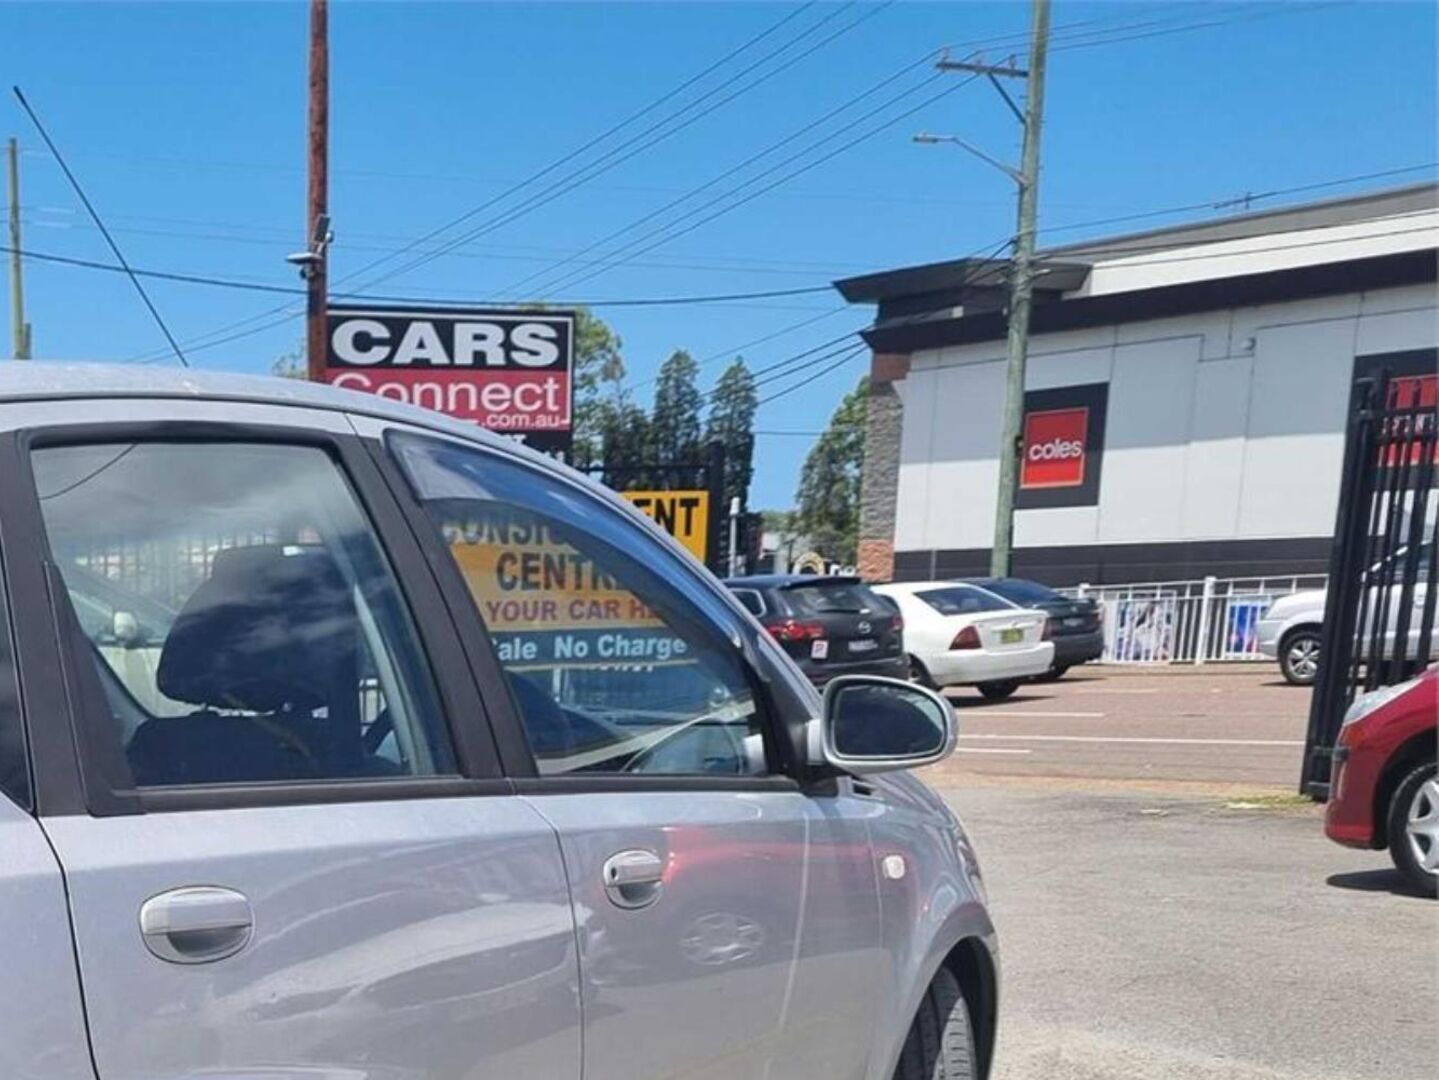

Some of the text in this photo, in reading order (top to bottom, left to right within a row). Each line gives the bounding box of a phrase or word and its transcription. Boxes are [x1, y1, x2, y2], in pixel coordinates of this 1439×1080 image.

[331, 319, 560, 367] CARS
[1029, 437, 1083, 461] coles
[496, 552, 625, 591] CENTR
[486, 600, 557, 621] YOUR
[568, 599, 620, 619] CAR
[554, 636, 588, 658] No
[597, 634, 688, 660] Charge
